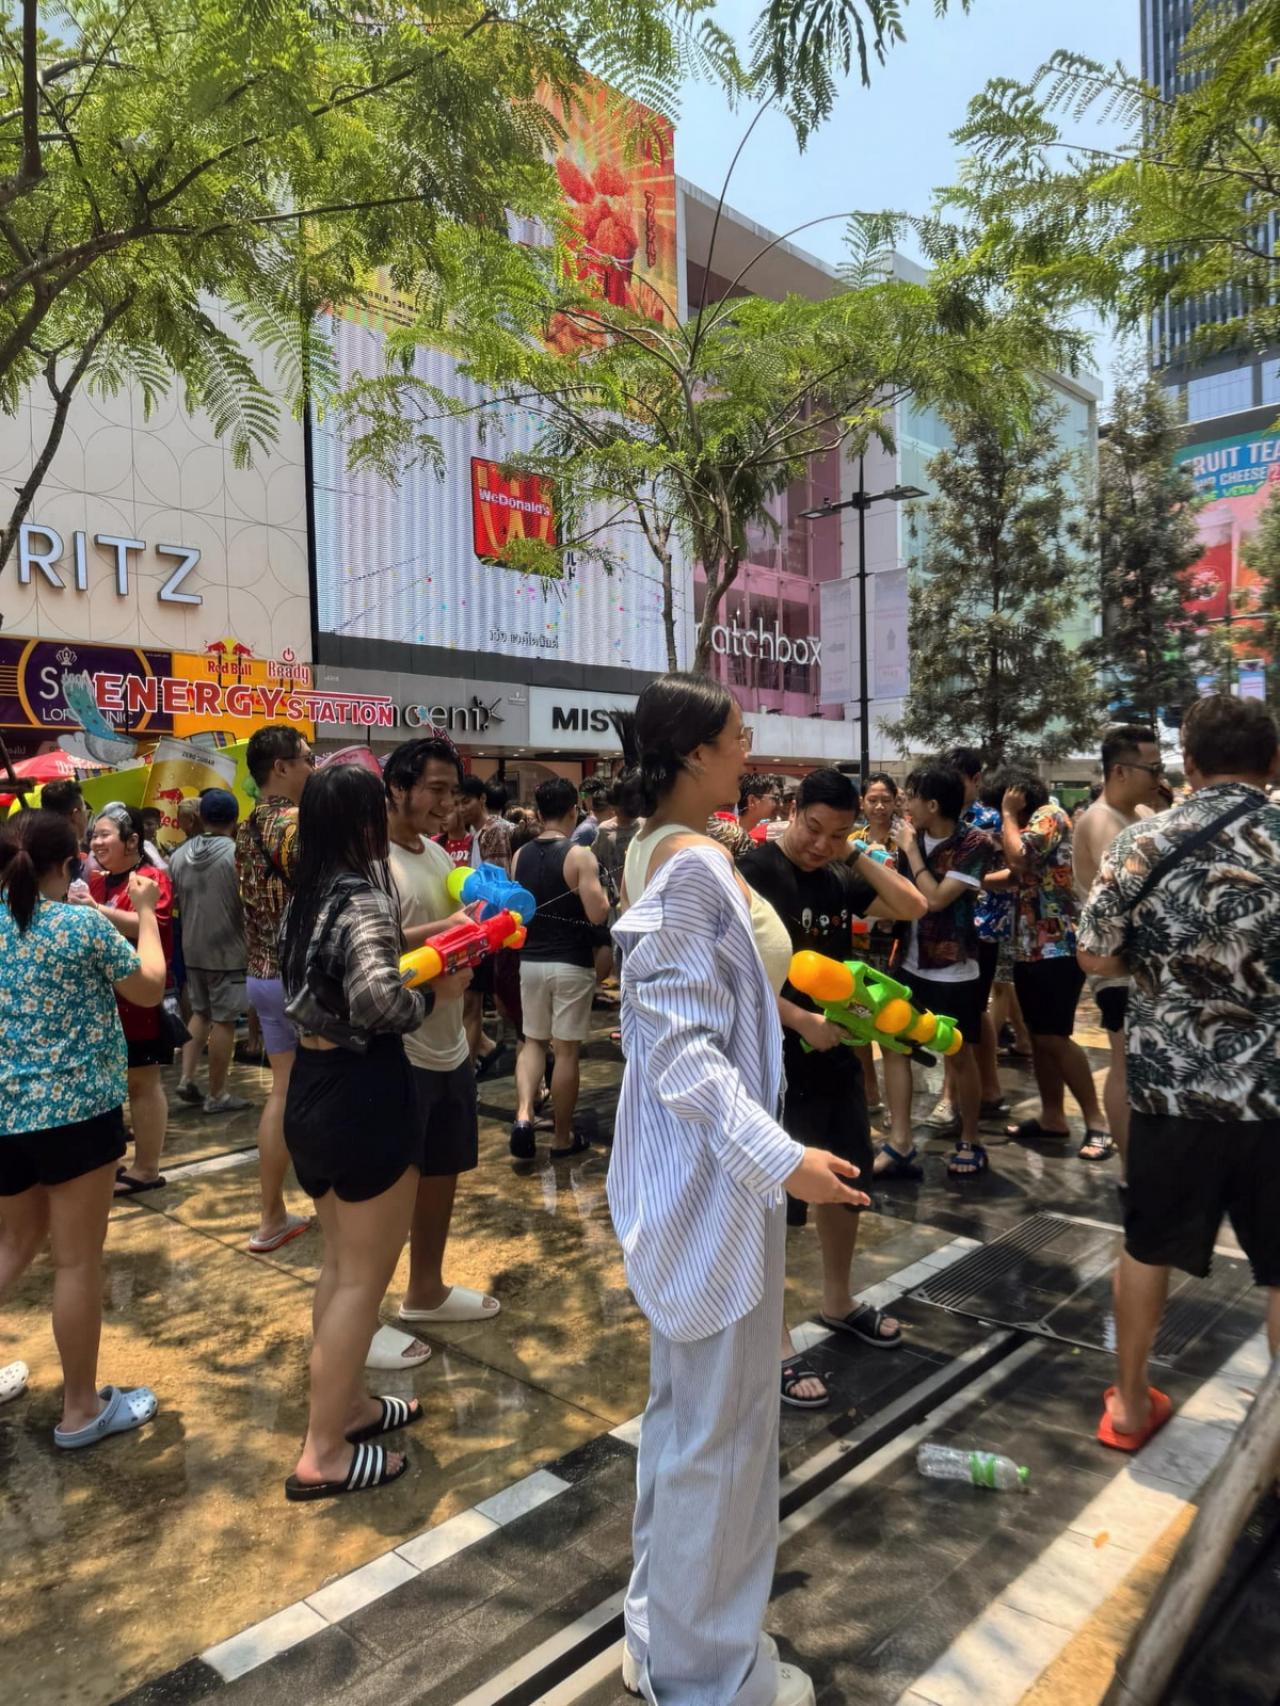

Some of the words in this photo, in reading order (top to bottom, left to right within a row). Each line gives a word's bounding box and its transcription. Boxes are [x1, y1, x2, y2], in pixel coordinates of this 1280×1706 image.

[1219, 466, 1268, 486] CHEESE
[479, 488, 552, 516] WcDonald's
[17, 522, 204, 606] RITZ
[696, 617, 822, 666] atchbox
[208, 660, 229, 674] Red
[231, 662, 252, 676] Bull
[267, 659, 310, 684] Ready
[92, 672, 286, 720] ENERGY
[286, 697, 394, 726] STATION
[553, 706, 612, 732] MIS
